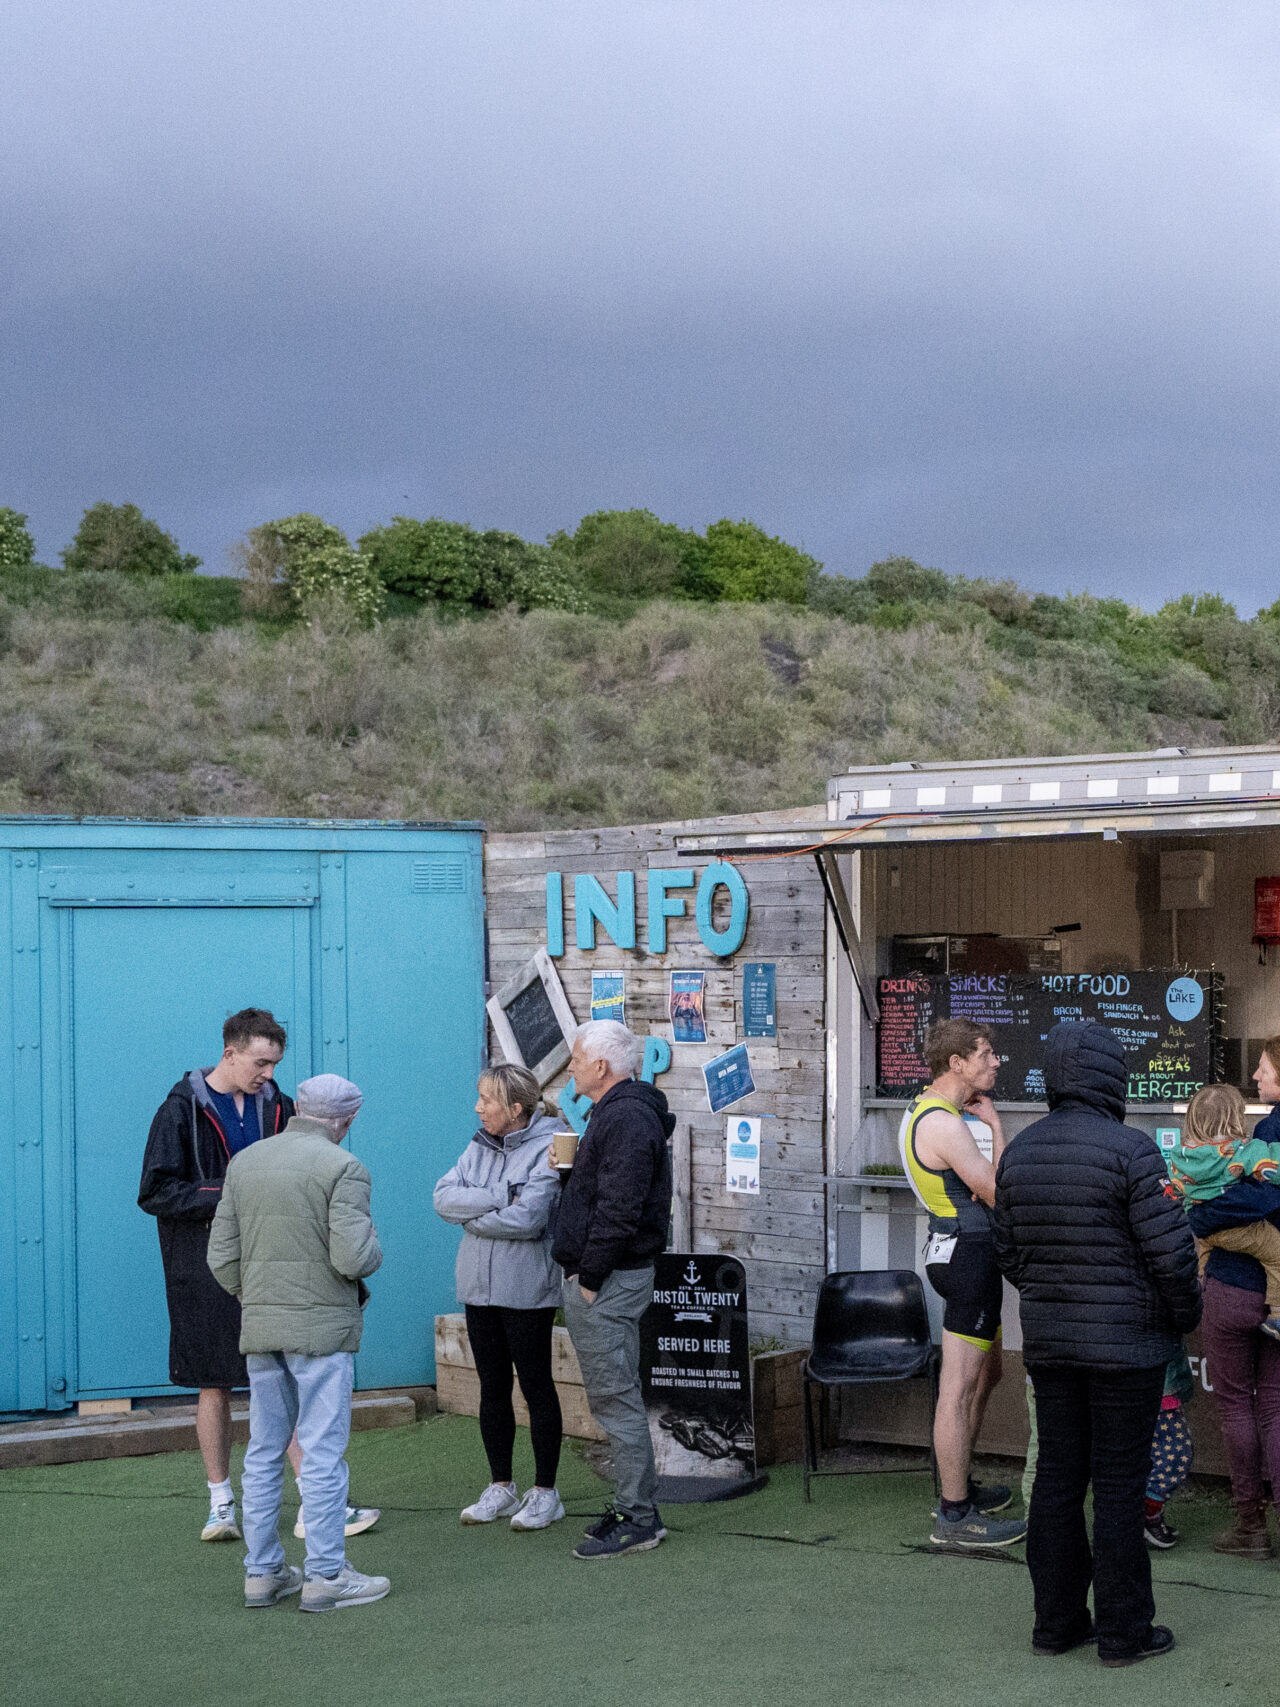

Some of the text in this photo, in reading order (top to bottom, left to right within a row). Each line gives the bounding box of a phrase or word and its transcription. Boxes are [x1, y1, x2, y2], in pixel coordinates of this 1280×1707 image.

[546, 861, 749, 956] INFO
[880, 979, 930, 994] DRINKS
[950, 975, 1006, 992] SNACKS
[1041, 974, 1130, 996] HOT FOOD
[1168, 993, 1195, 1003] LAKE
[1053, 1007, 1082, 1016] BACON
[1116, 1003, 1144, 1013] FINGER
[1103, 1012, 1139, 1020] SANDWICH
[1169, 1025, 1186, 1036] Ask
[1149, 1060, 1191, 1072] PIZZAS
[653, 1290, 739, 1306] RISTOL TWENTY
[658, 1336, 731, 1353] SERVED HERE
[651, 1367, 739, 1379] ROASTED IN SMALL BATCHES TO
[651, 1378, 741, 1389] ENSURE FRESHNESS OF FLAVOUR
